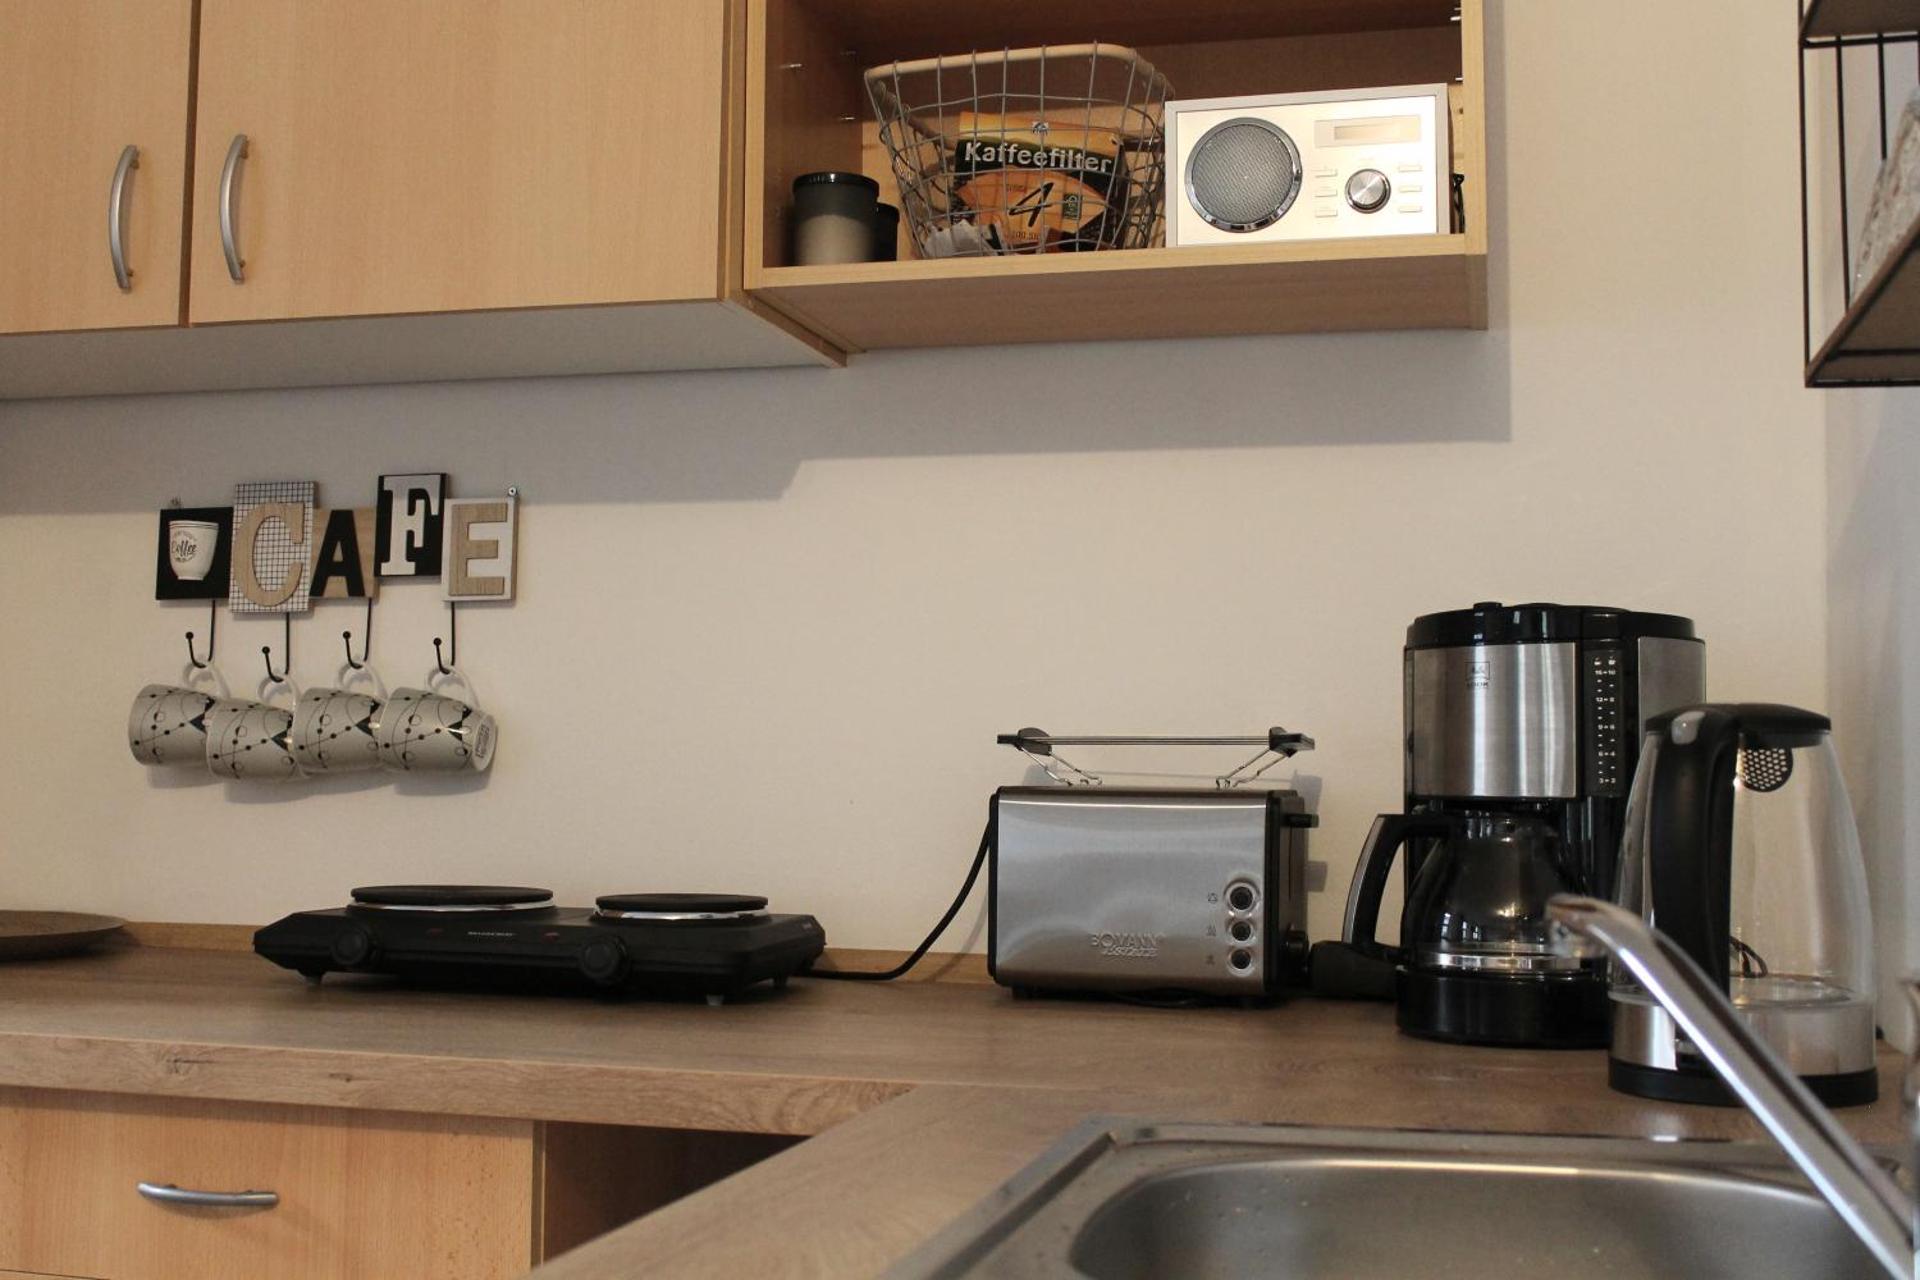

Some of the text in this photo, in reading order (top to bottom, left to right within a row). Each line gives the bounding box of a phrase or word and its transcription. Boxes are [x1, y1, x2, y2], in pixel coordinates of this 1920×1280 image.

[964, 141, 1112, 173] Kaffeefilter
[1008, 181, 1055, 228] 4
[233, 474, 508, 607] CAFE
